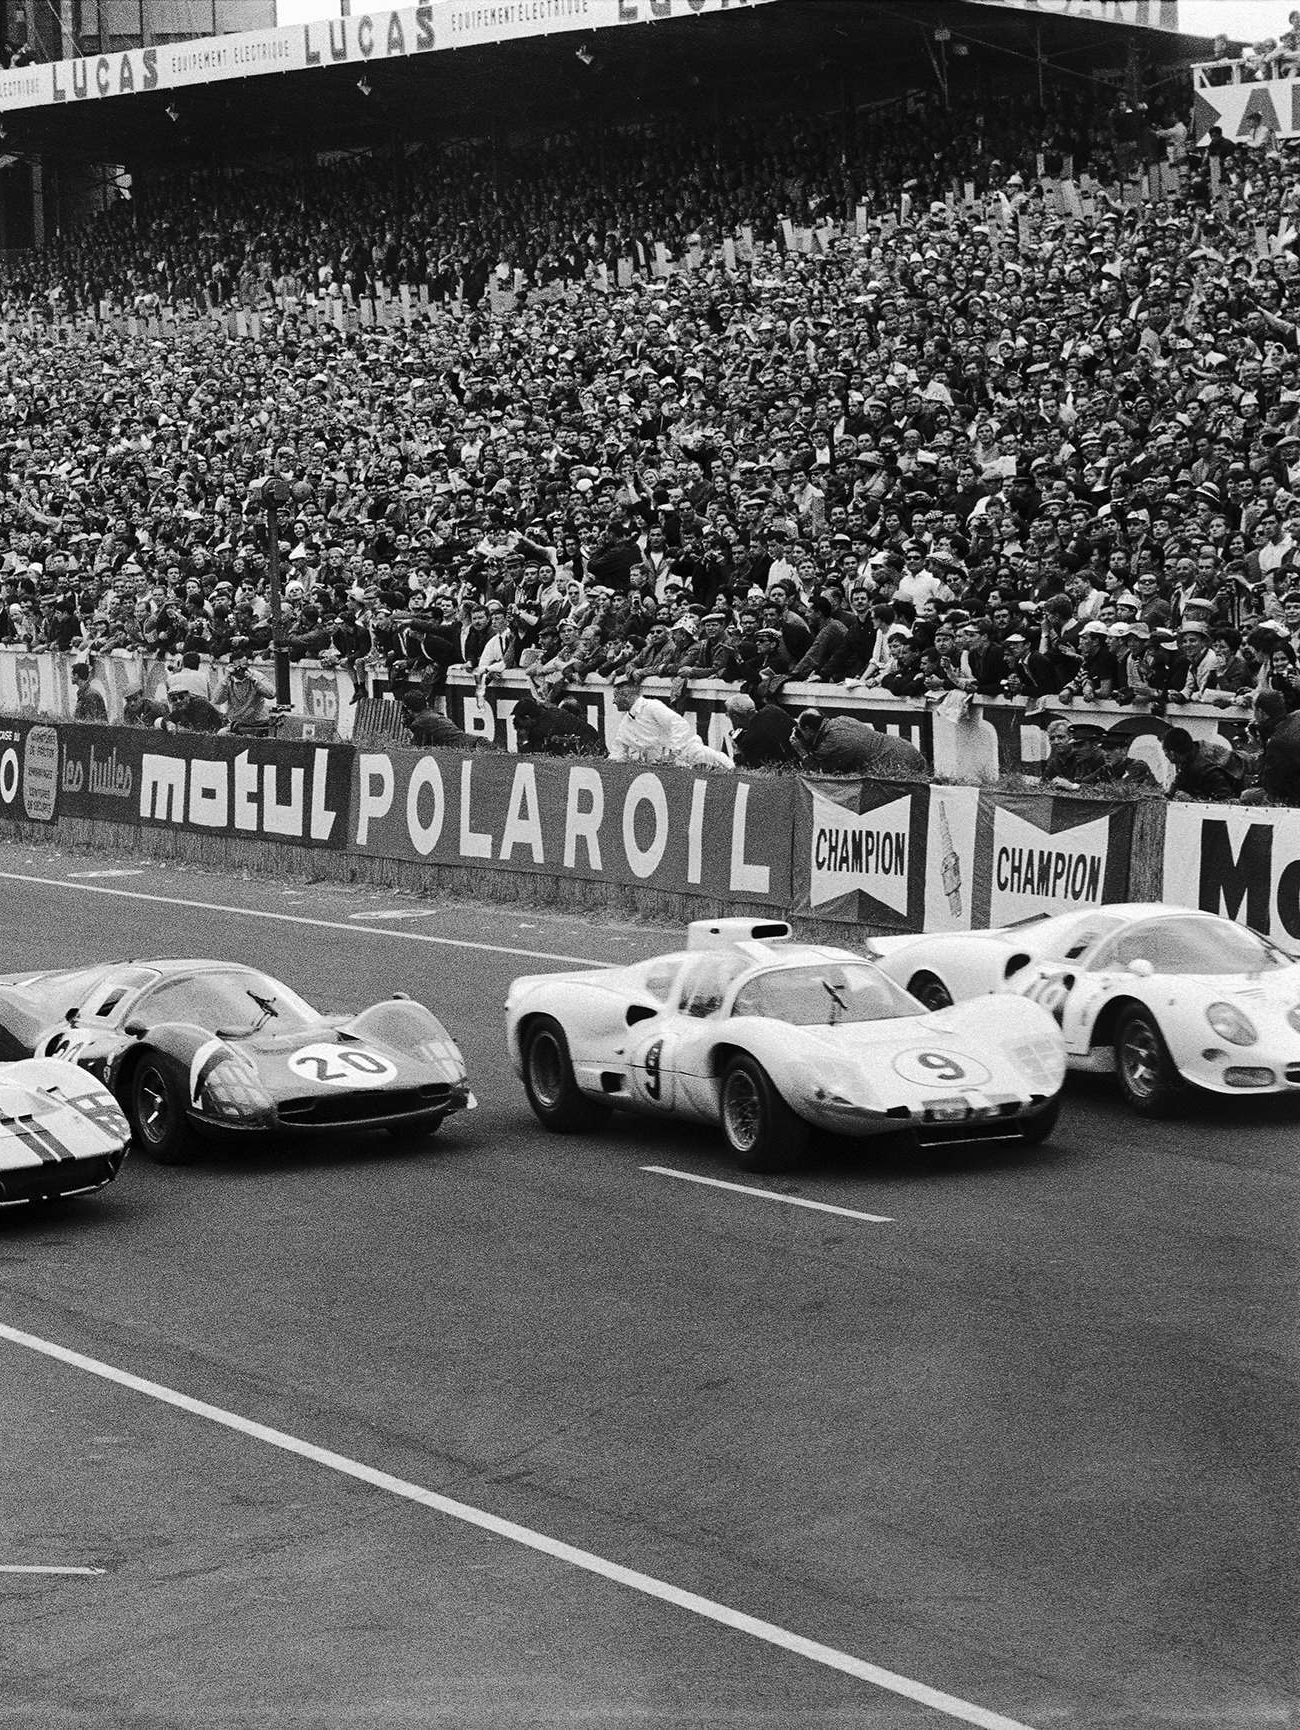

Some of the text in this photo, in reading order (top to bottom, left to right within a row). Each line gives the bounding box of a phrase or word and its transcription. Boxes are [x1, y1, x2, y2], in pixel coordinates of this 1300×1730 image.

[305, 8, 434, 65] LUCAS
[53, 49, 158, 102] LUCAS
[140, 748, 336, 841] motul
[356, 753, 771, 893] POLAROIL
[815, 828, 906, 876] CHAMPION
[997, 845, 1102, 902] CHAMPION
[296, 1051, 388, 1082] 20
[645, 1039, 663, 1100] 9
[917, 1053, 966, 1081] 9
